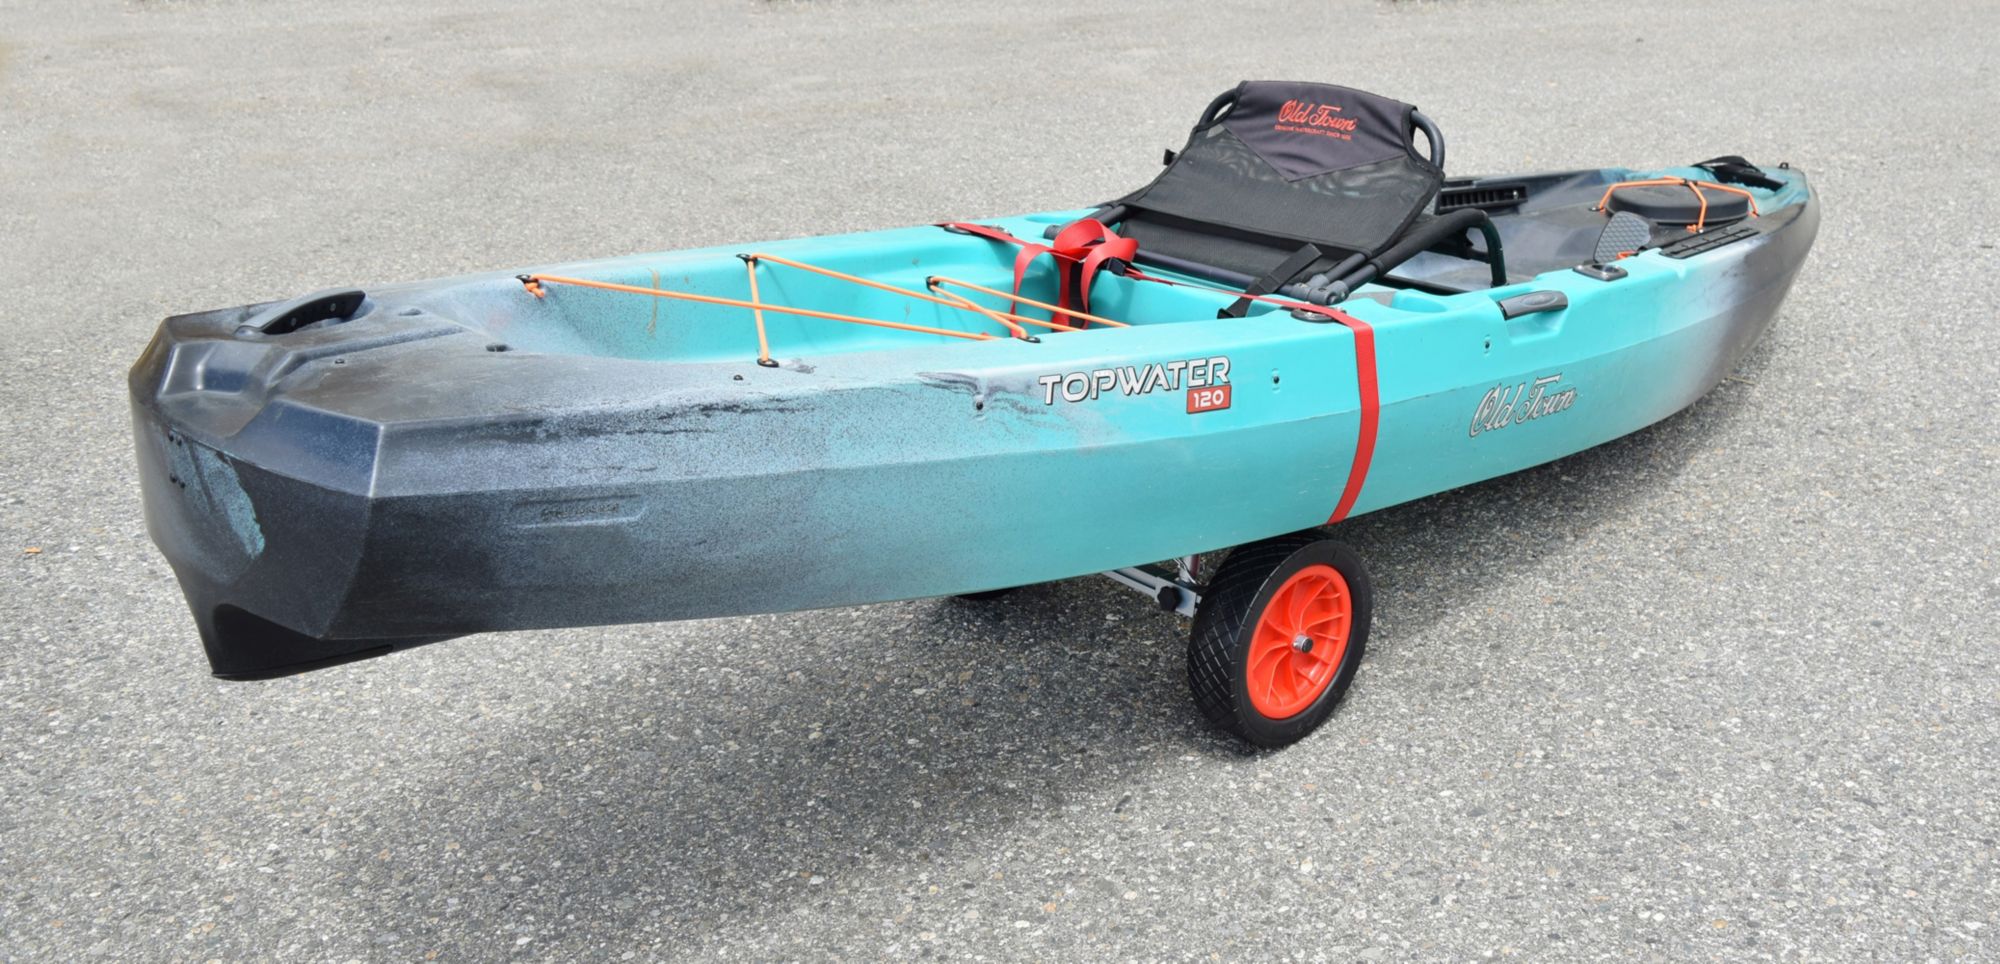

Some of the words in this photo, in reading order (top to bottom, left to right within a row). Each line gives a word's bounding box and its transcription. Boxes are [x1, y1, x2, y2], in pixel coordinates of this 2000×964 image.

[1279, 99, 1314, 123] Old
[1309, 104, 1356, 131] Town
[1039, 356, 1231, 405] TOPWATER
[1192, 389, 1225, 408] 120
[1469, 382, 1526, 438] Old
[1515, 372, 1577, 424] Town
